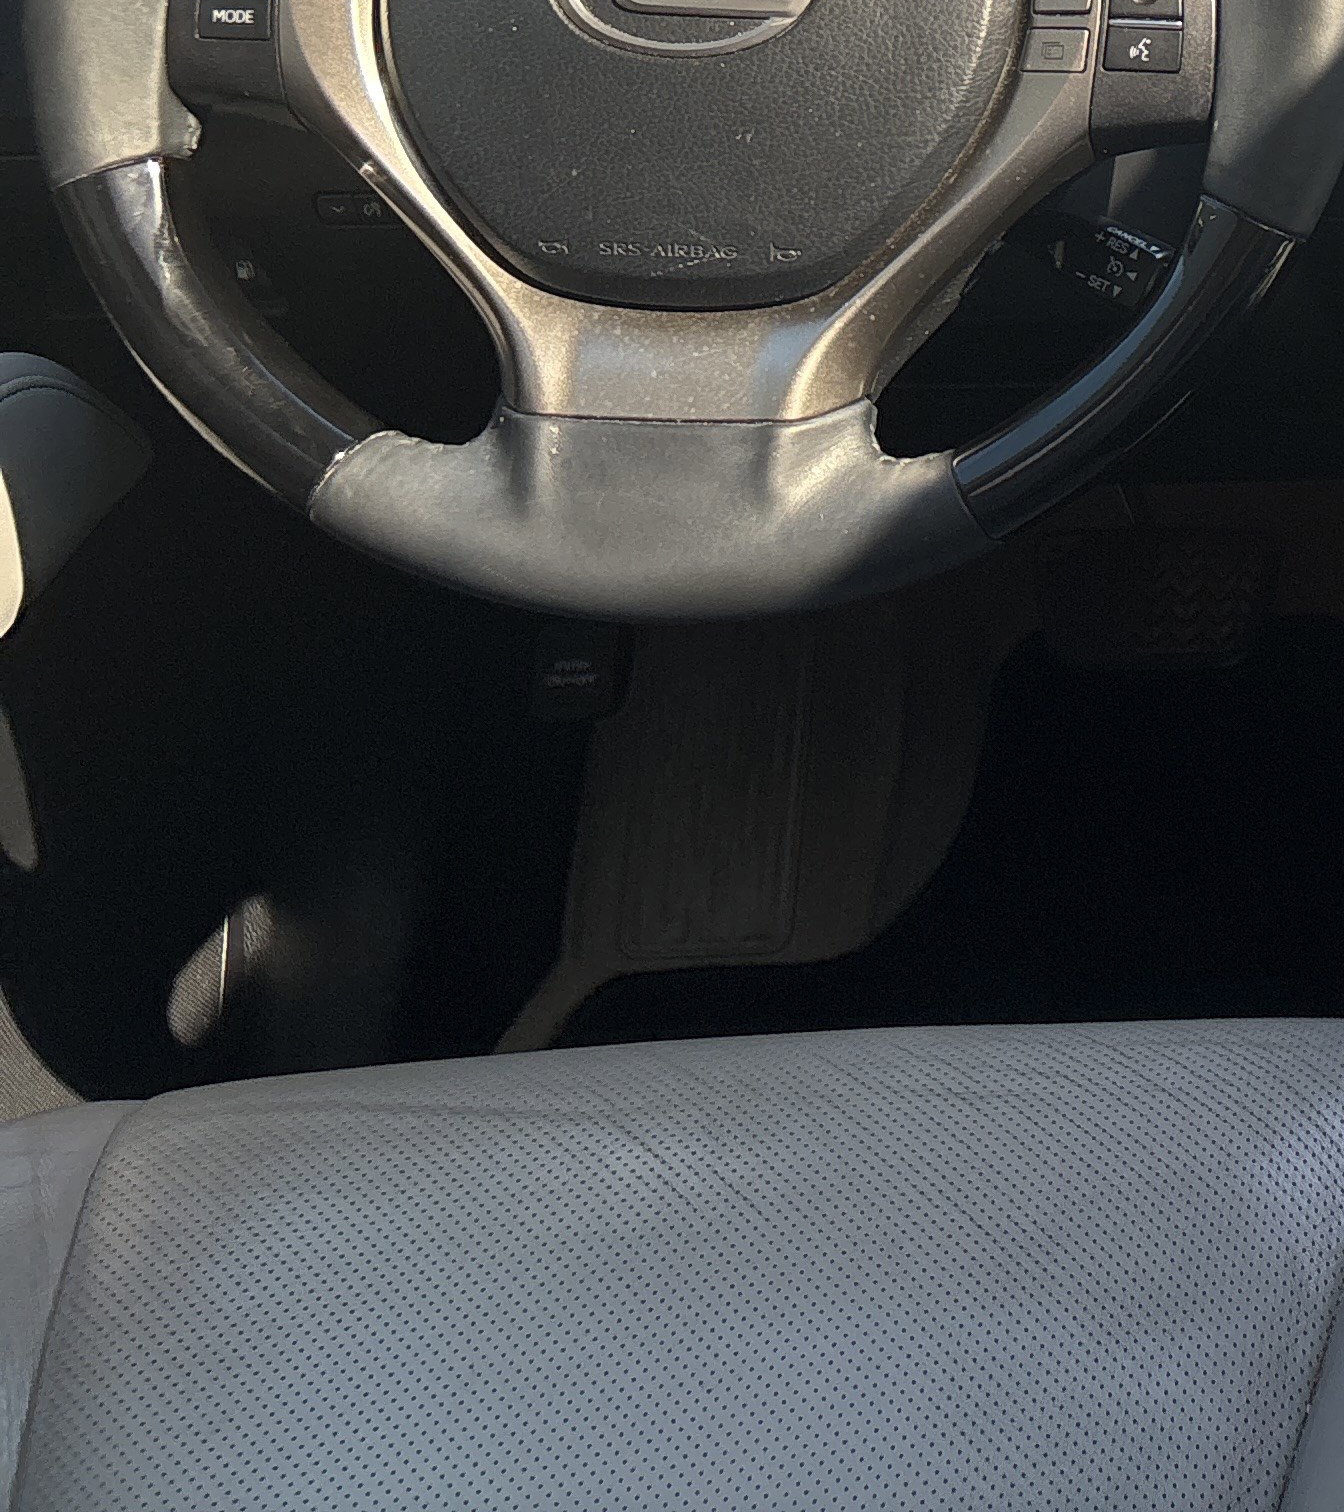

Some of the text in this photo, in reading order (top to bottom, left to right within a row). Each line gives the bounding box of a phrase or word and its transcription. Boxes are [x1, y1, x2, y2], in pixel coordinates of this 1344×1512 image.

[212, 9, 255, 24] MODE
[1106, 236, 1131, 255] RES
[1087, 274, 1111, 293] SET
